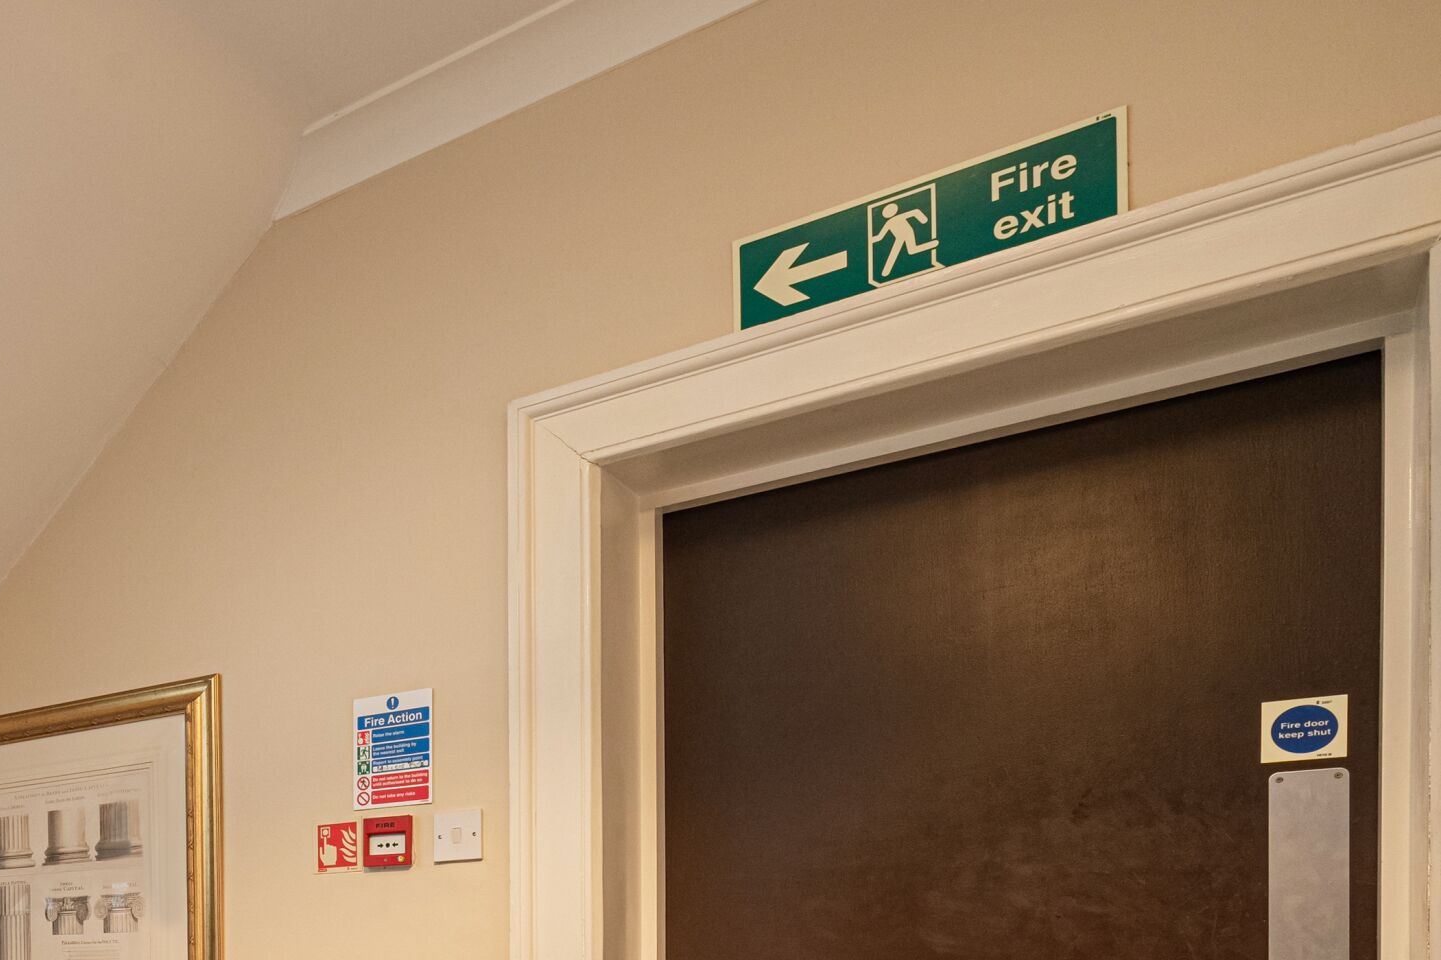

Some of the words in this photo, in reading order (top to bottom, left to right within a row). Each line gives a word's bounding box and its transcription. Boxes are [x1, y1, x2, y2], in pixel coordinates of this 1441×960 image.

[990, 153, 1077, 202] Fire
[993, 190, 1075, 240] exit
[364, 717, 385, 727] Fire
[388, 711, 422, 724] Action
[1304, 720, 1329, 728] door
[1278, 731, 1304, 739] keep
[1307, 729, 1331, 737] shut
